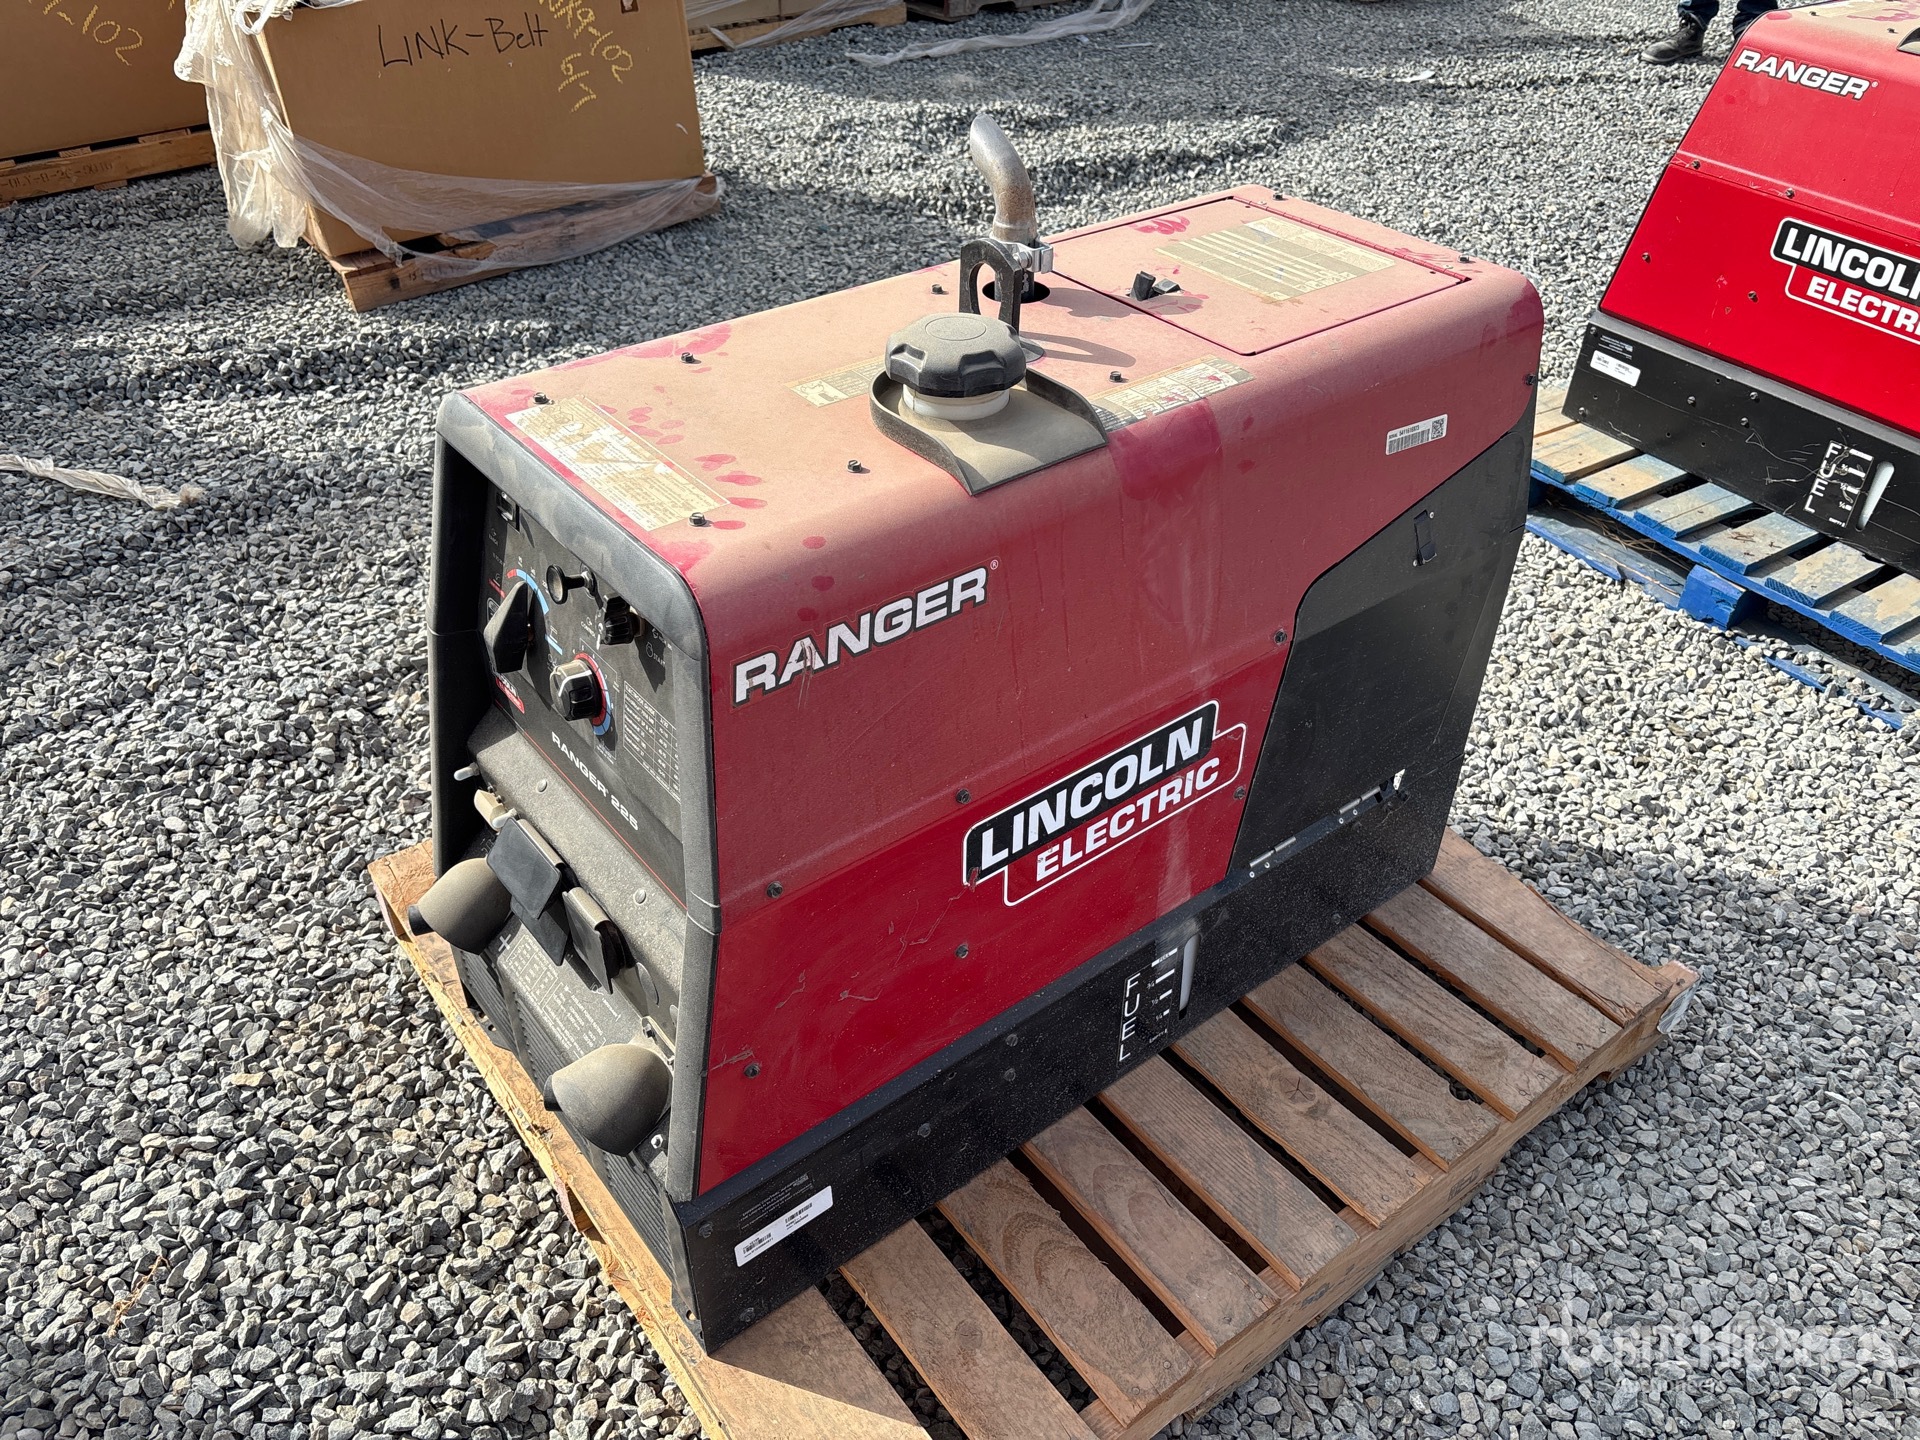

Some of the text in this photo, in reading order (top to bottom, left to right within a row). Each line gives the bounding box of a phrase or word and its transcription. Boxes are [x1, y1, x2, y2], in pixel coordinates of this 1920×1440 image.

[377, 12, 549, 67] LINK-Belt
[1804, 442, 1842, 514] FUEL
[551, 731, 607, 797] RANGER
[611, 794, 639, 831] 225
[981, 716, 1203, 871] LINCOLN
[1036, 757, 1220, 882] ELECTRIC
[1119, 972, 1141, 1062] FUEL
